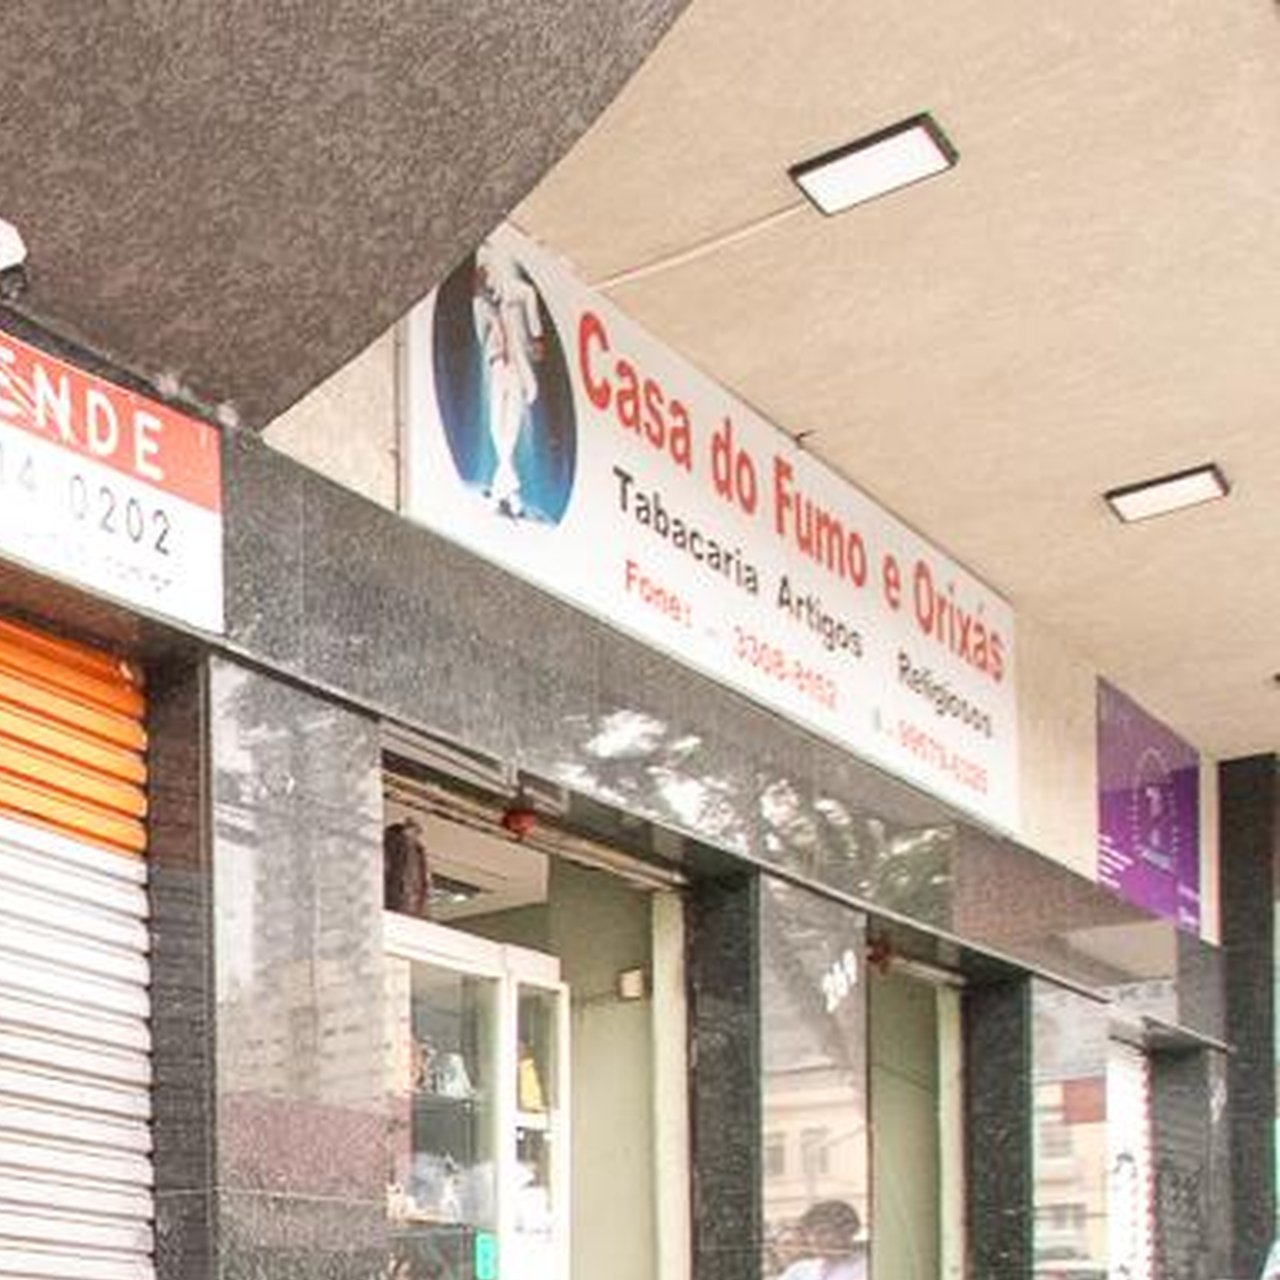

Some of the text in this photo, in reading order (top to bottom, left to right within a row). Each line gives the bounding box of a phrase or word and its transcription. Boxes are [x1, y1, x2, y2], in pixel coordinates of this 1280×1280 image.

[69, 473, 172, 556] 0202
[578, 310, 693, 475] Casa
[711, 416, 757, 516] do
[773, 454, 867, 588] Fumo
[882, 553, 901, 611] e
[612, 464, 759, 597] Tabacaria
[776, 574, 863, 659] Artigos
